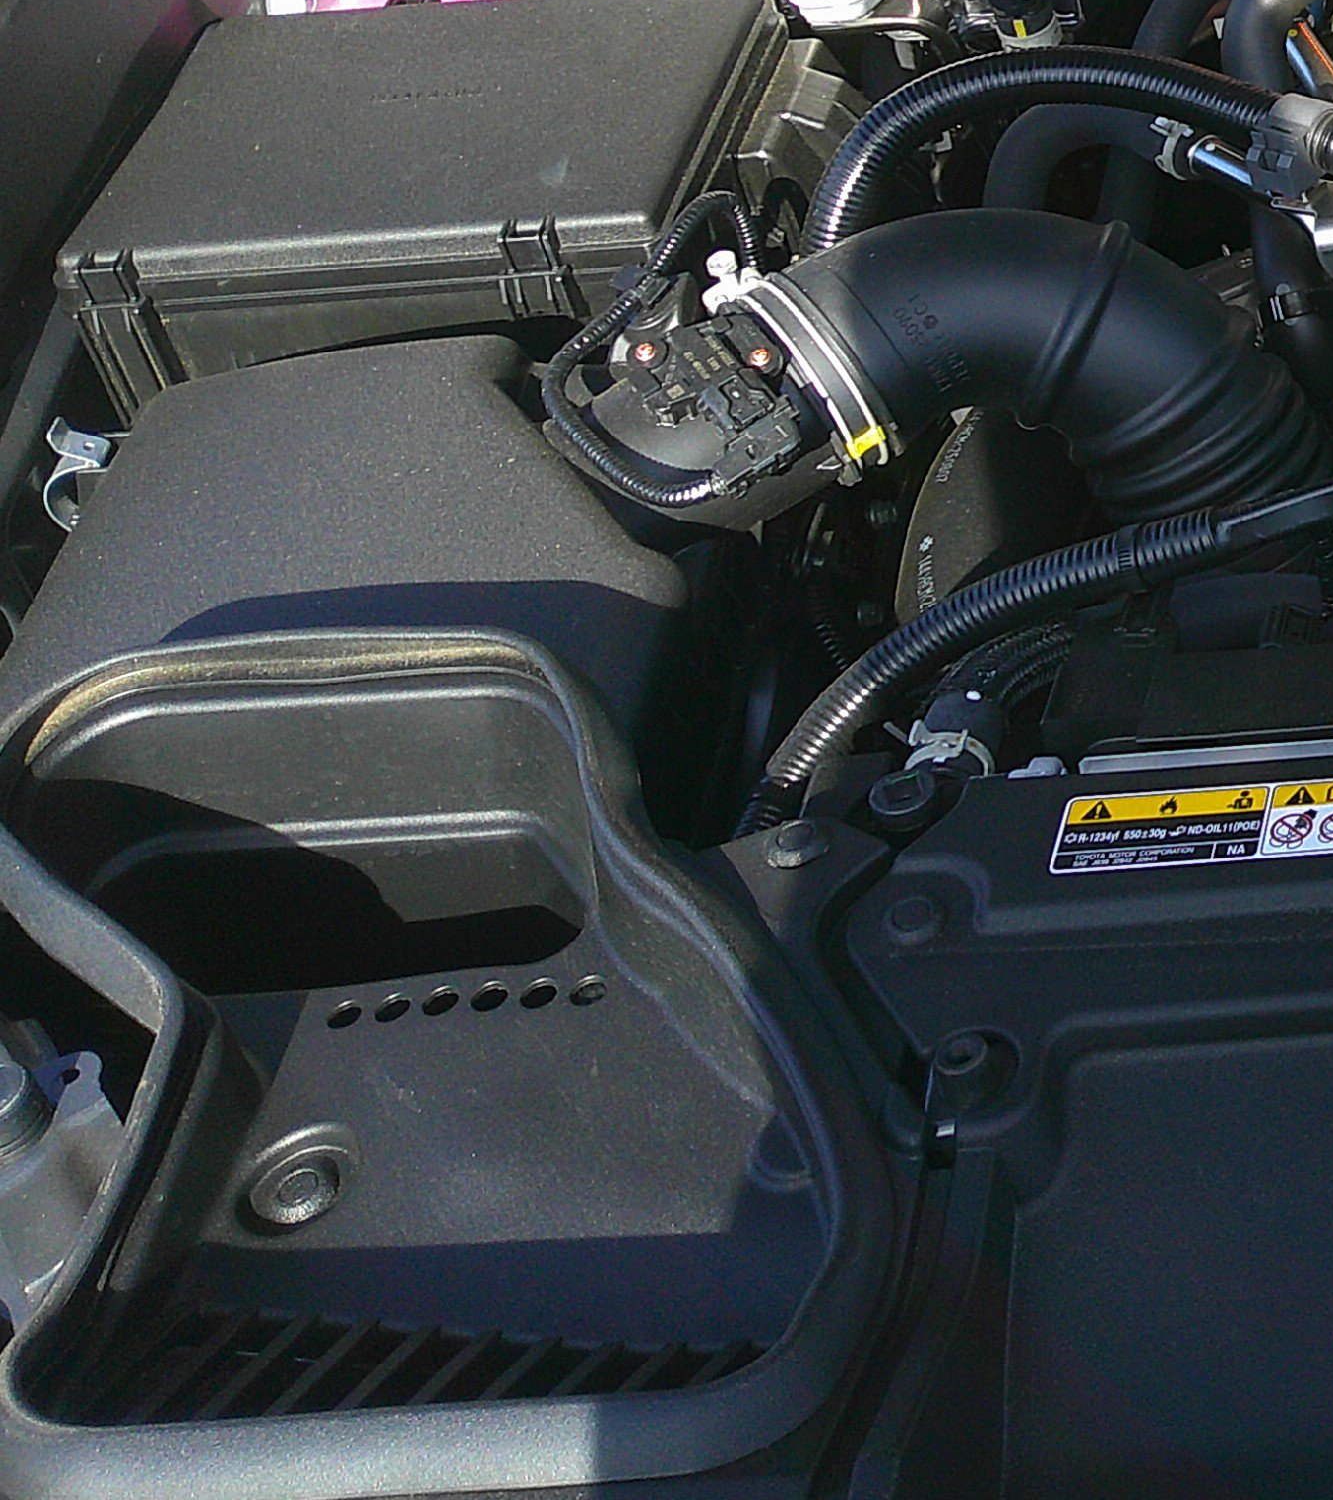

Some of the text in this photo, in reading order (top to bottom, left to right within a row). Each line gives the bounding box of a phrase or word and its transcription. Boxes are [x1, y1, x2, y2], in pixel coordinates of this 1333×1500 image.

[1075, 846, 1195, 861] TOYOTA MOTOR CORPORATION
[1226, 844, 1246, 856] NA
